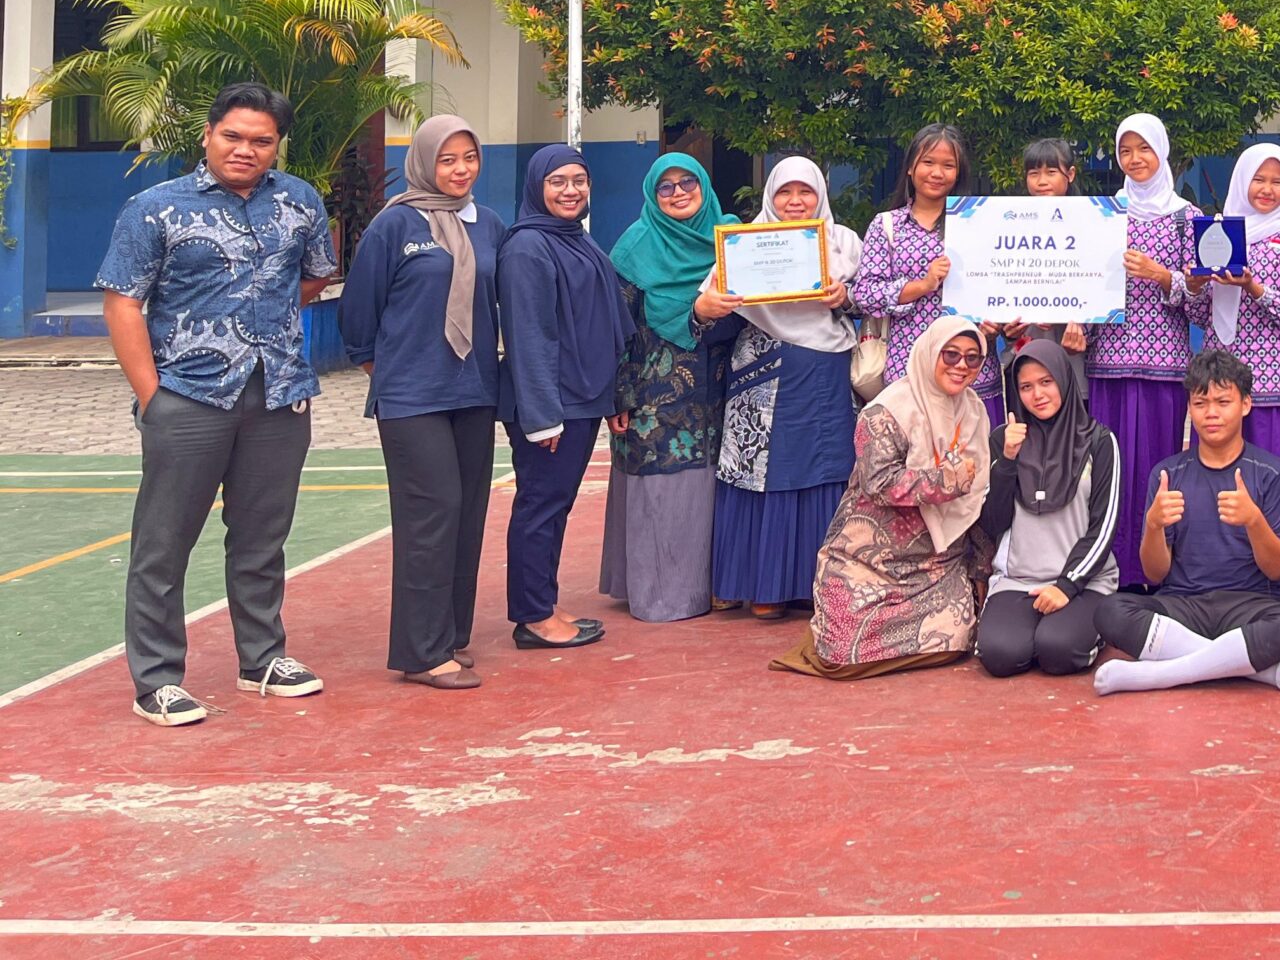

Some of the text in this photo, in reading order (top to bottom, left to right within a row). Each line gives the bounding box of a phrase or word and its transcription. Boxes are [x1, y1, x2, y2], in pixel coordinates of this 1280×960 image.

[1019, 211, 1039, 220] AMS
[994, 235, 1076, 250] JUARA 2
[990, 257, 1081, 269] SMP N 20 DEPOK
[987, 296, 1087, 309] RP. 1.000.000,-
